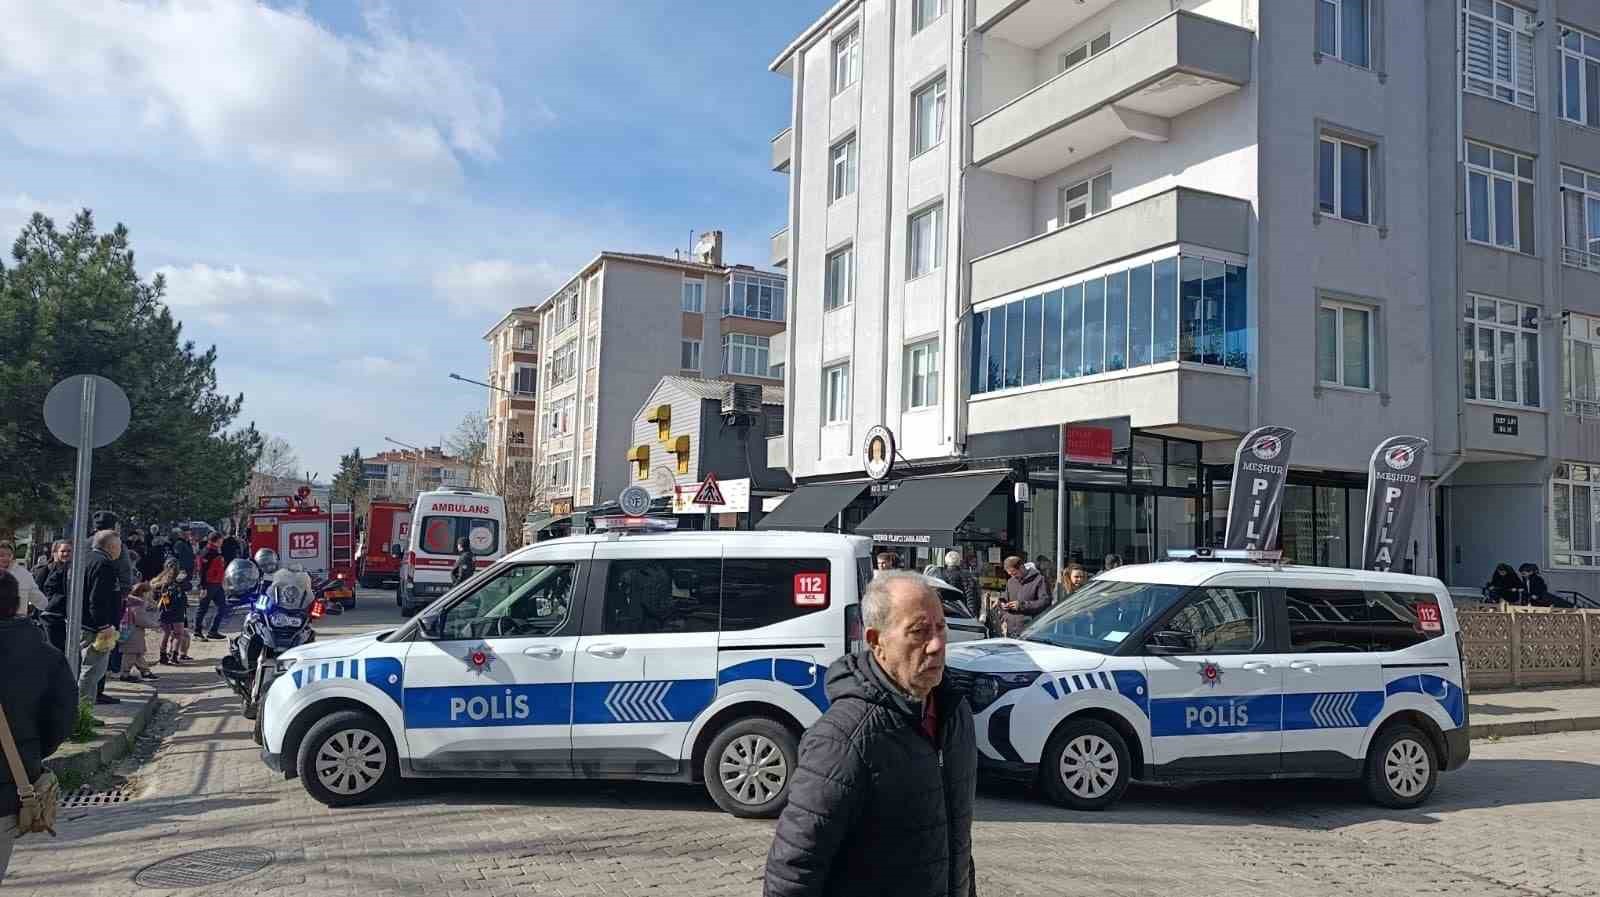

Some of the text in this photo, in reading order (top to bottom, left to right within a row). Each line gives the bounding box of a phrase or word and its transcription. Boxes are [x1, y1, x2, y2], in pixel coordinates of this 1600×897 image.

[1242, 461, 1284, 475] MEŞHUR
[431, 503, 490, 515] AMBULANS
[294, 534, 315, 548] 112
[799, 576, 822, 593] 112
[1420, 607, 1438, 621] 112
[450, 688, 530, 721] POLİS
[1184, 699, 1249, 729] POLİS
